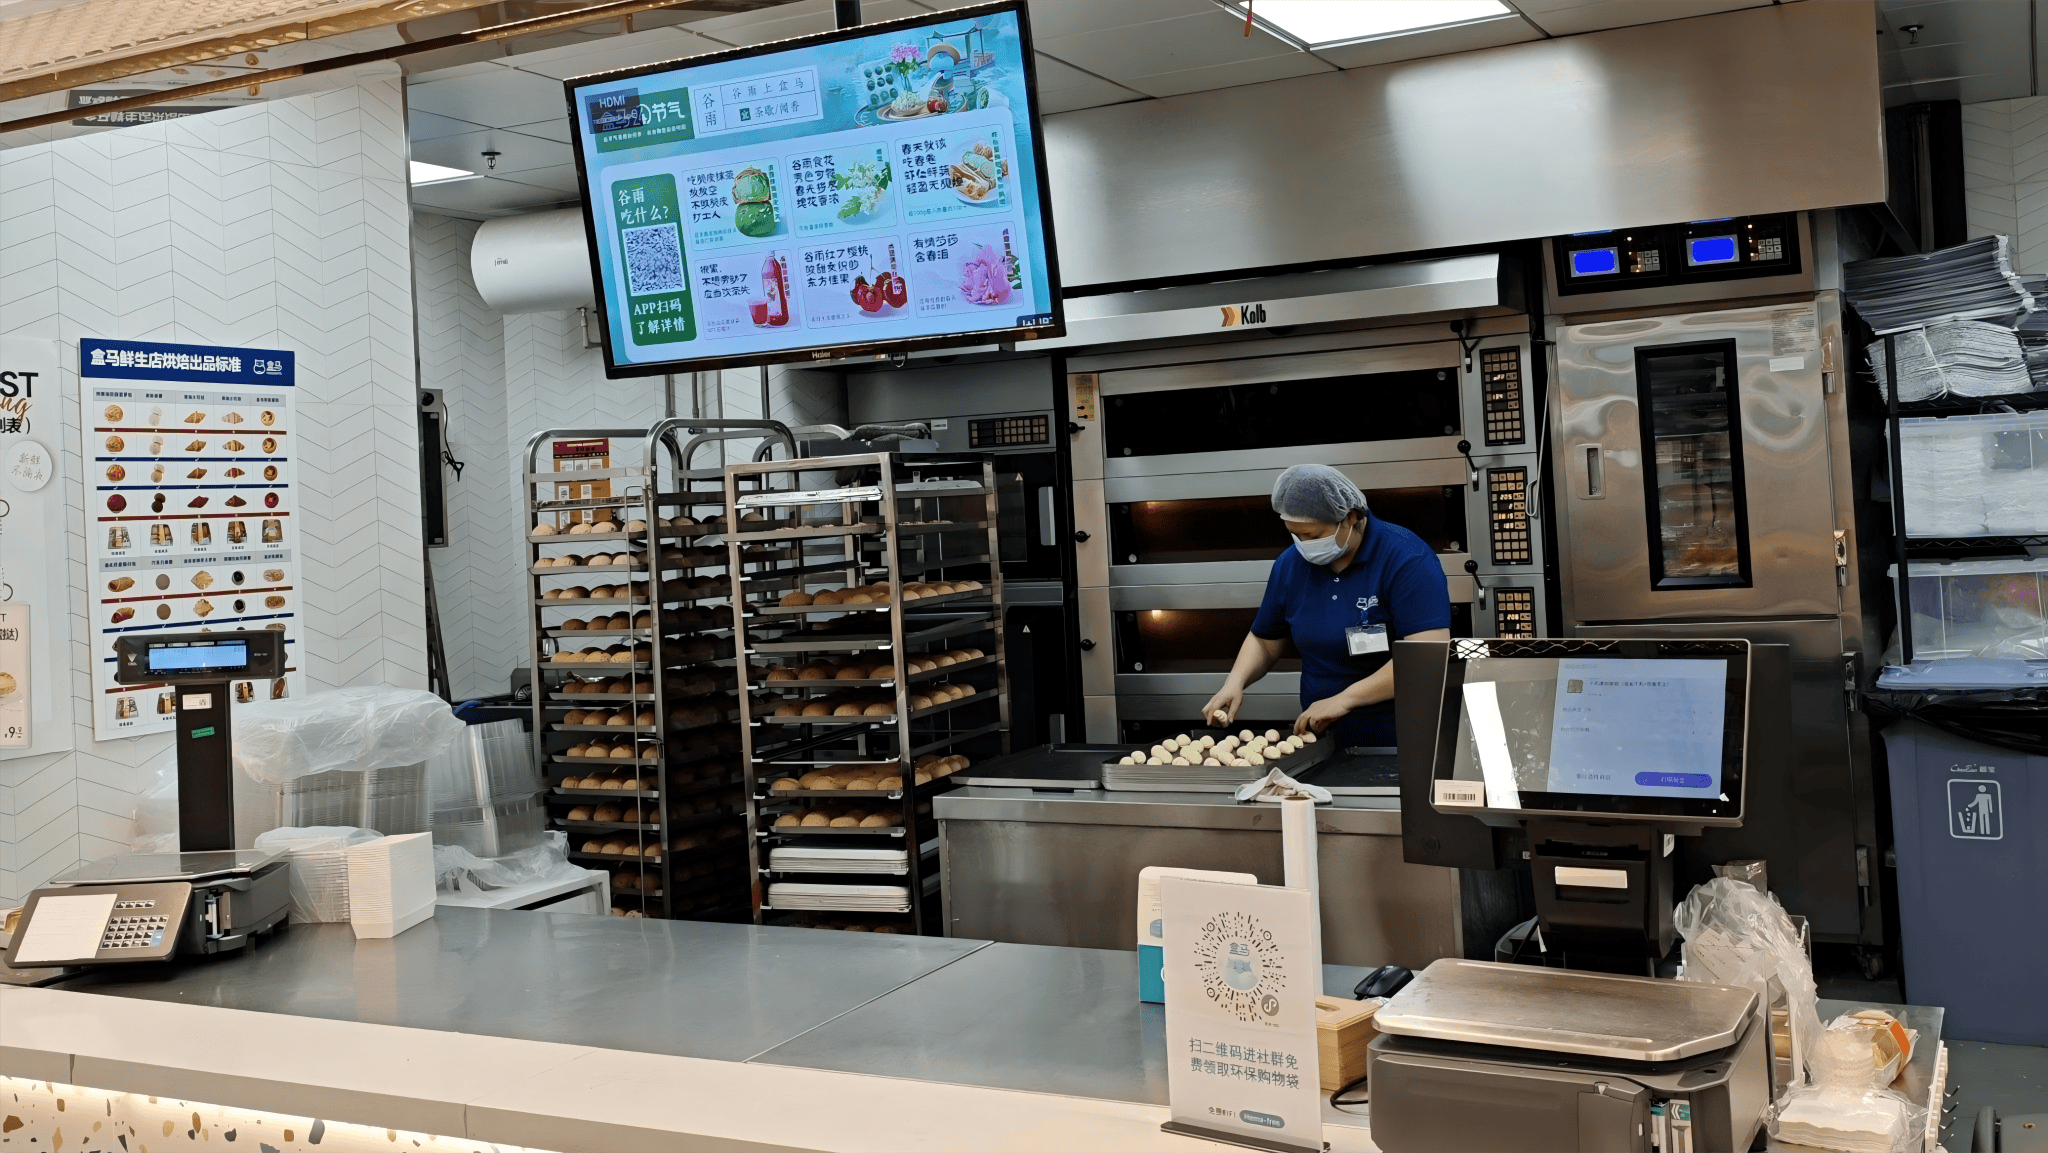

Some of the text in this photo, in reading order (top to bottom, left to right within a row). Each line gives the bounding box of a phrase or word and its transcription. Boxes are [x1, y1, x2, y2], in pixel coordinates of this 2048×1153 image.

[599, 95, 625, 108] HDMI
[702, 92, 716, 126] 谷雨
[903, 154, 936, 167] 吃春卷
[618, 187, 644, 206] 谷雨
[804, 245, 869, 263] 谷雨红了樱桃
[914, 249, 949, 263] 含春泪
[807, 273, 850, 287] 东方佳果
[634, 298, 682, 316] APP扫码
[1241, 304, 1266, 325] Kolb
[636, 316, 685, 335] 了解详情
[90, 348, 242, 373] 盒马鲜生店烘焙出品标准
[1189, 1037, 1299, 1070] 扫二维码进社群免
[1190, 1057, 1299, 1089] 费领取环保购物袋
